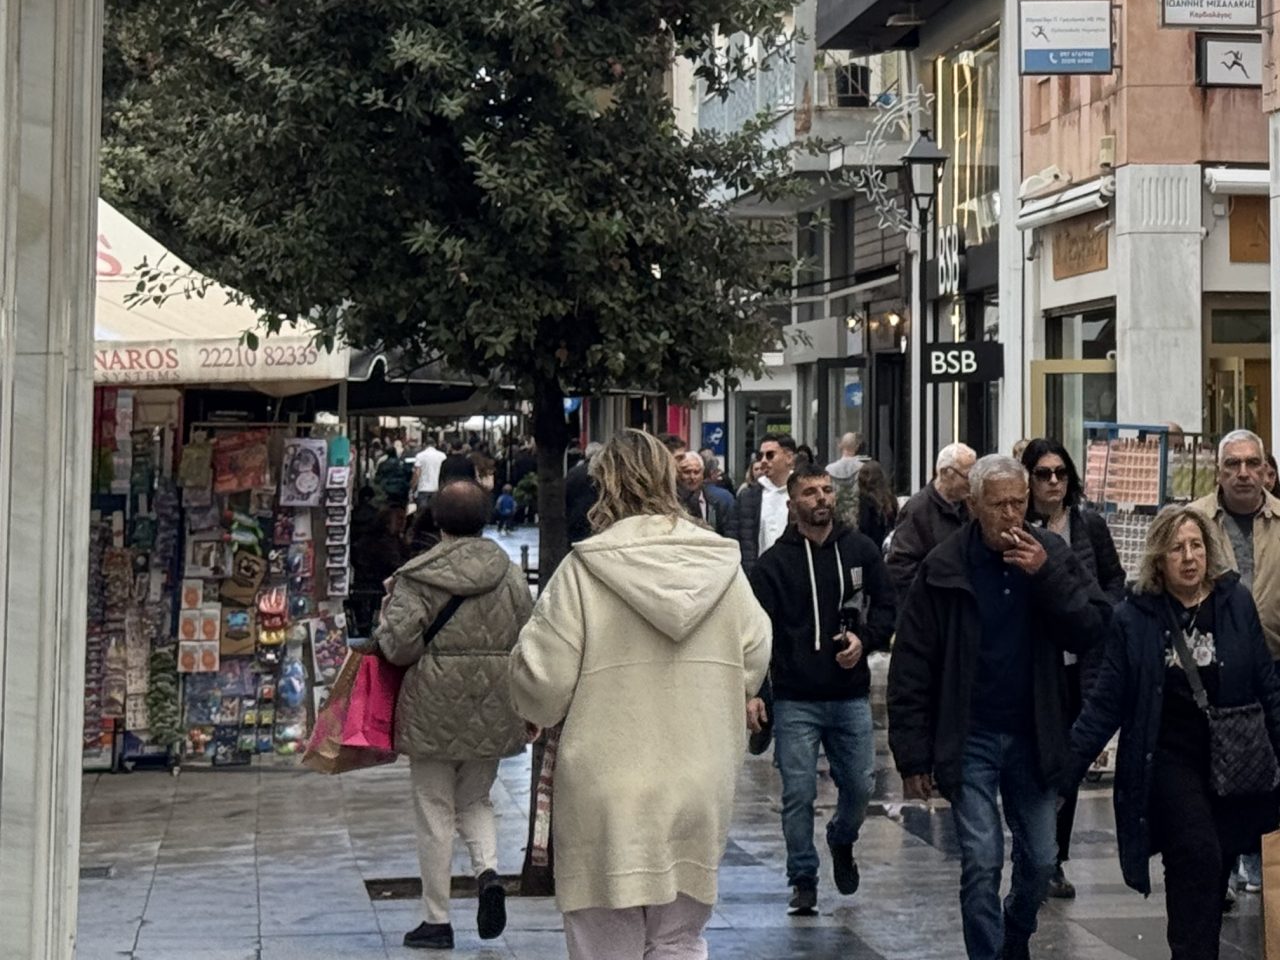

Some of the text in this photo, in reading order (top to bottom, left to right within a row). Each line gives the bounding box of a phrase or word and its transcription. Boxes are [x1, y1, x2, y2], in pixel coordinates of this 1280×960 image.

[938, 224, 960, 296] BSB
[200, 345, 257, 368] 22210
[930, 350, 978, 375] BSB
